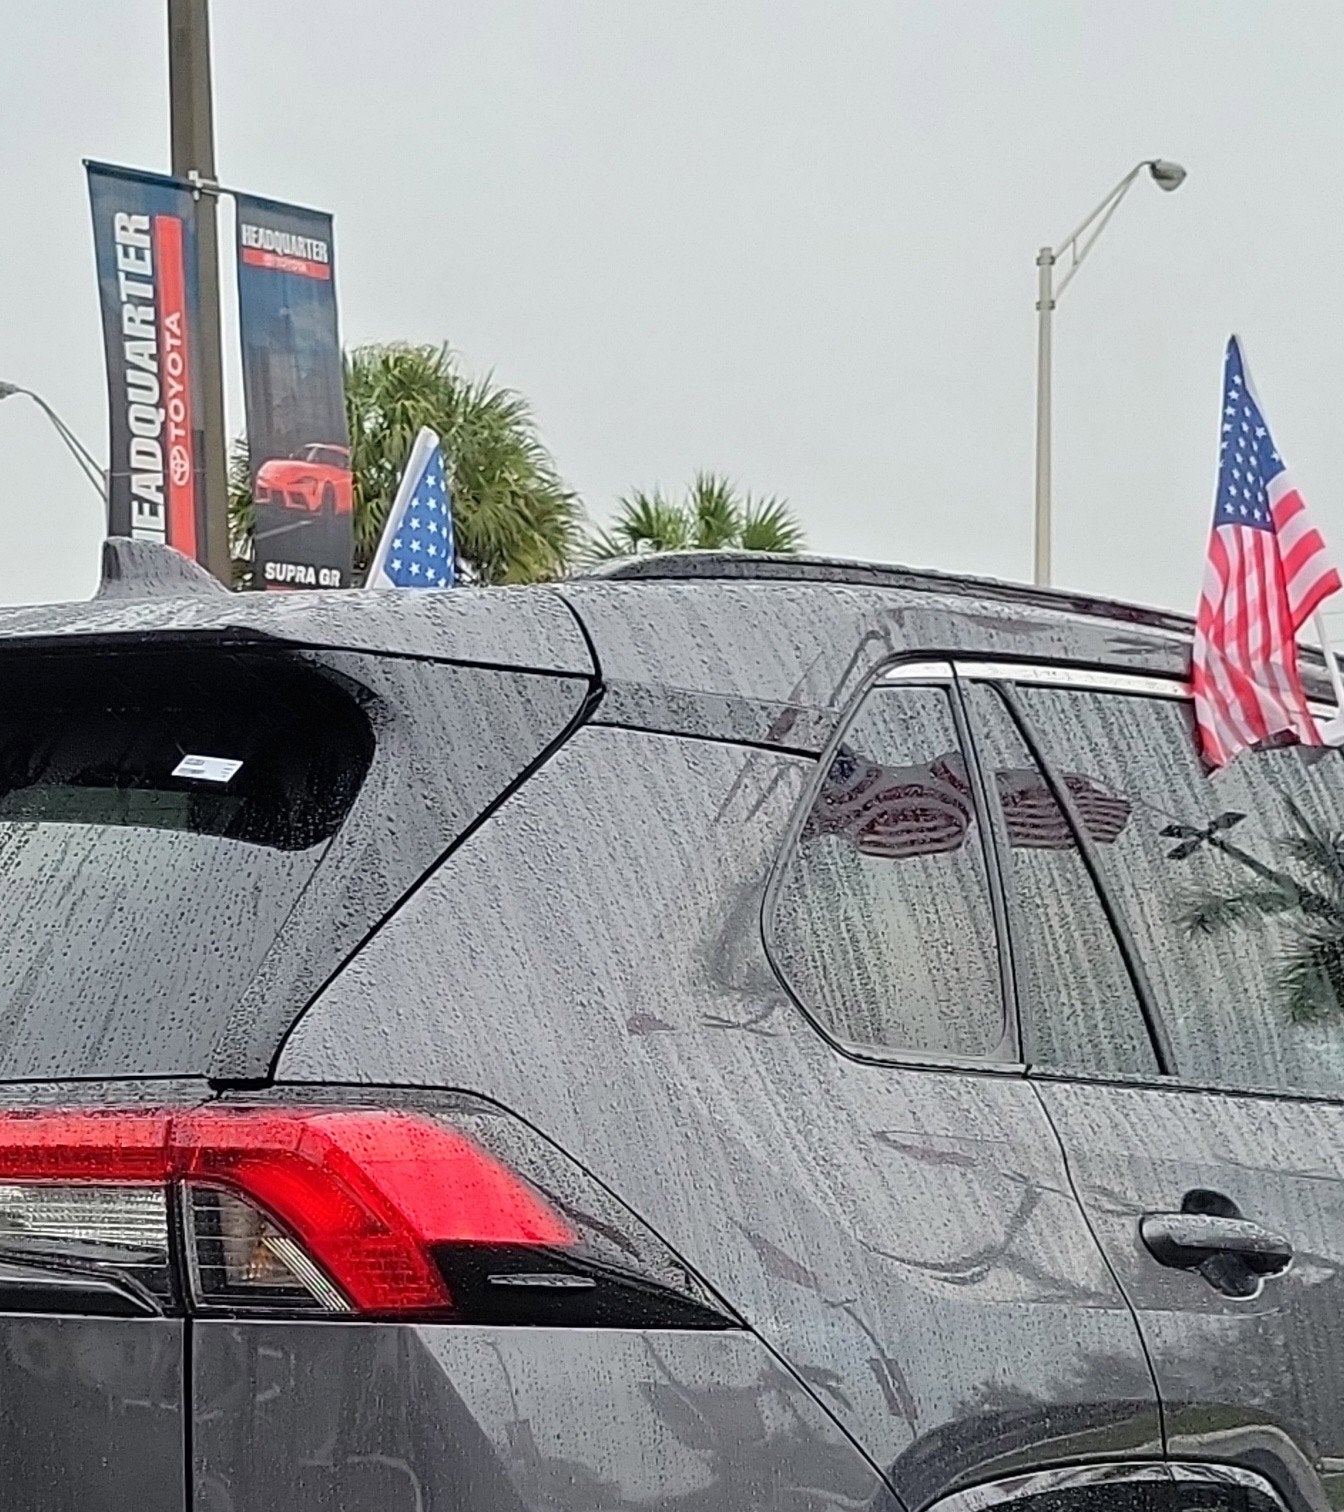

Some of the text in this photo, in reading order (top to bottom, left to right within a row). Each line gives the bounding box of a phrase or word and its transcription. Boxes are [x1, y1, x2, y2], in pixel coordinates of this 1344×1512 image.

[241, 223, 328, 263] HEADQUARTER
[163, 311, 189, 443] TOYOTA
[264, 562, 341, 588] SUPRA GR
